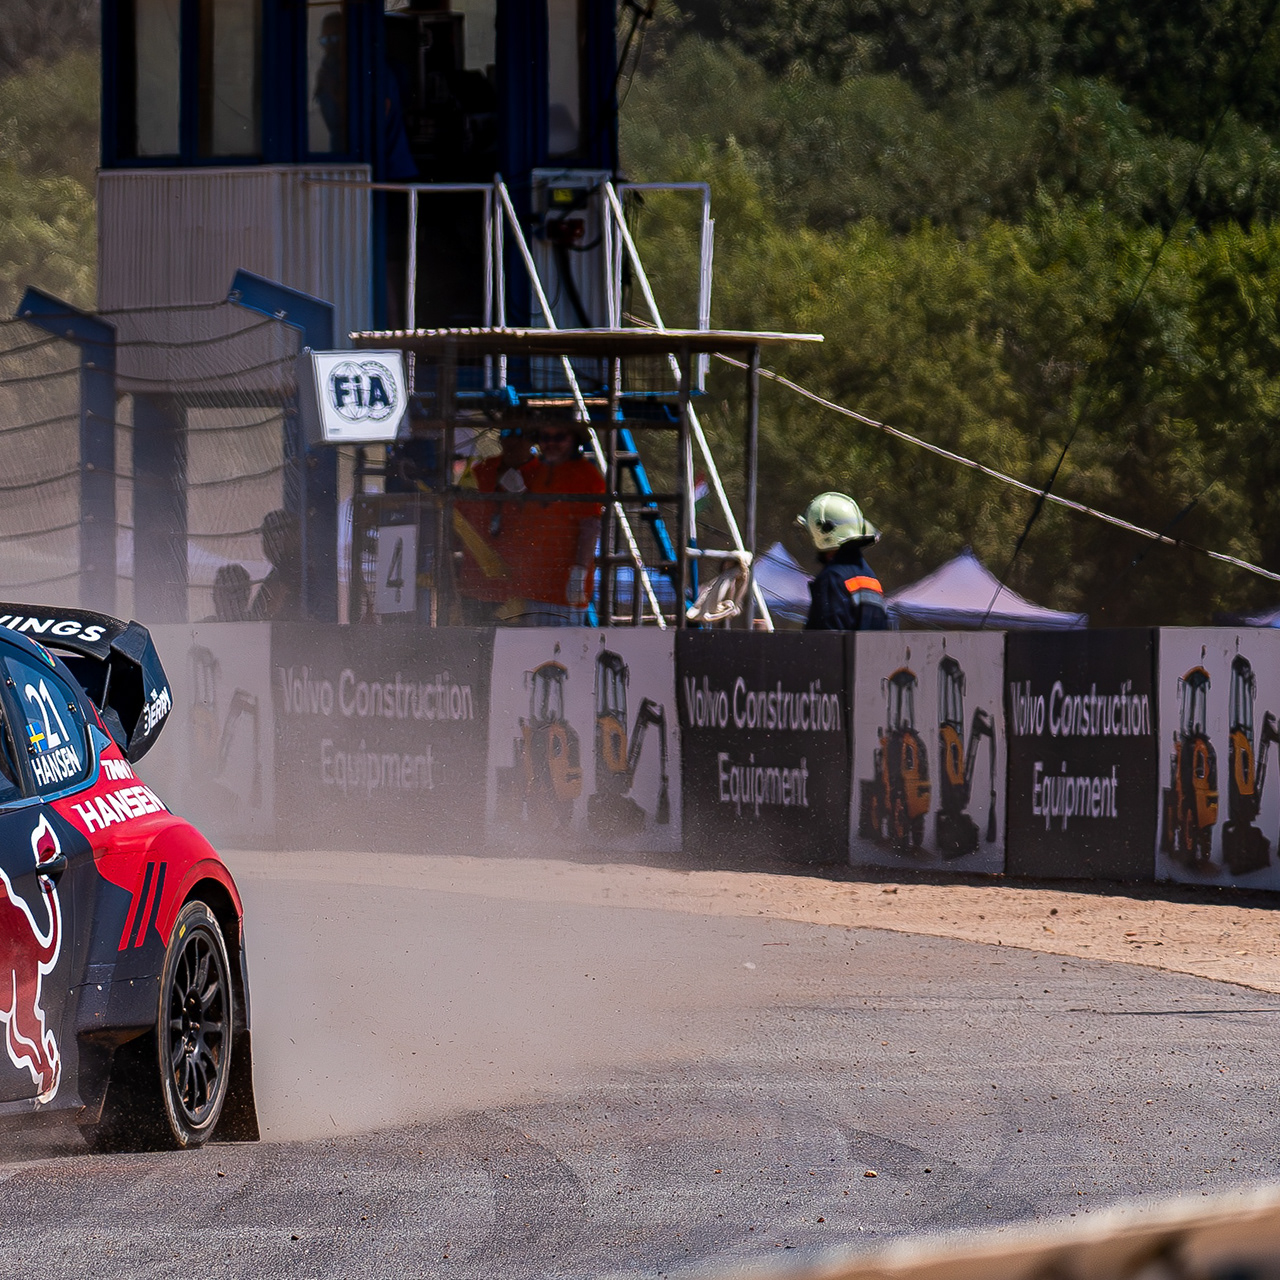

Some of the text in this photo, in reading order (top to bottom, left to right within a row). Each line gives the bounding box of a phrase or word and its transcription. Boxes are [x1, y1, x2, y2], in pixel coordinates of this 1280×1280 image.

[333, 375, 390, 407] FIA
[386, 536, 404, 603] 4
[25, 678, 70, 749] 21
[341, 668, 474, 720] Construction
[683, 675, 841, 732] Volvo Construction
[1010, 679, 1151, 737] Volvo Construction
[31, 744, 82, 786] HANSEN
[321, 738, 435, 798] Equipment
[718, 752, 809, 817] Equipment
[71, 785, 166, 833] HANSEN
[1032, 760, 1118, 832] Equipment
